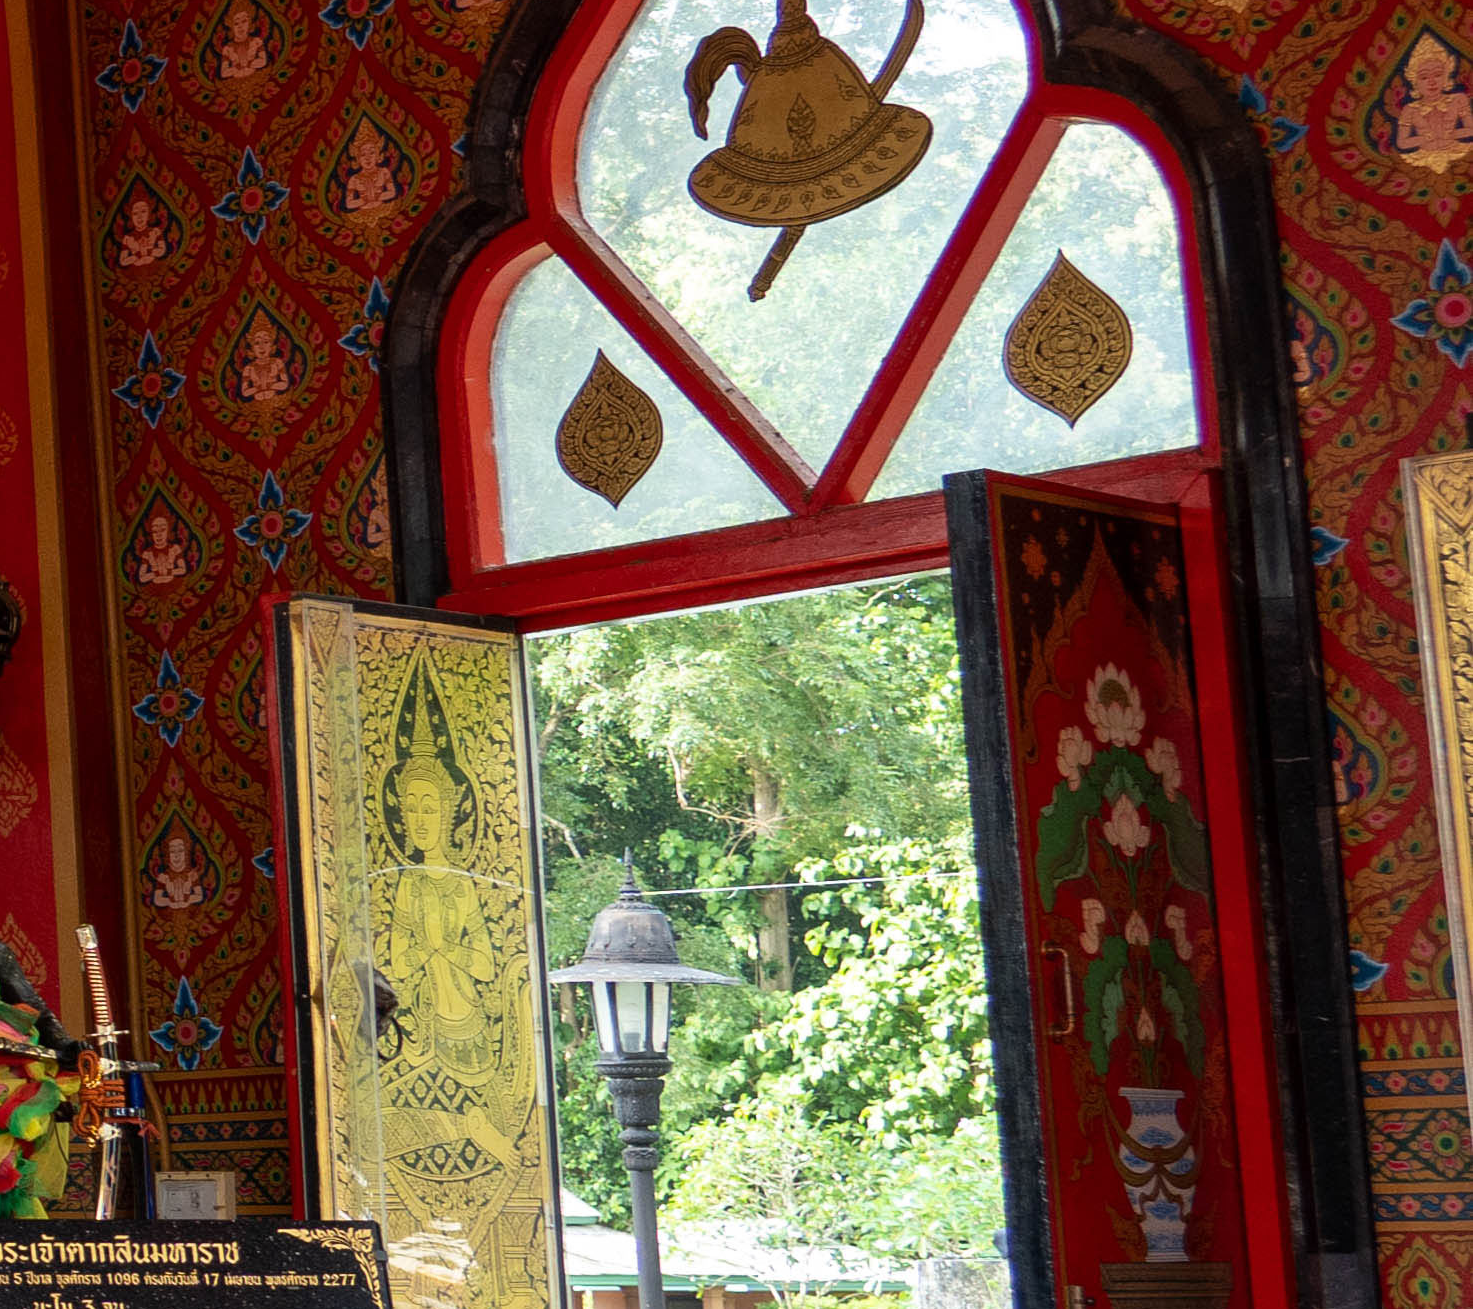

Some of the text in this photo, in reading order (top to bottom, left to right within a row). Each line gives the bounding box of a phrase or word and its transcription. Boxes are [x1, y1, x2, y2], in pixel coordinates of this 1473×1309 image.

[13, 1272, 22, 1284] 5
[106, 1273, 139, 1285] 1096
[204, 1274, 219, 1286] 17
[322, 1274, 356, 1286] 2277
